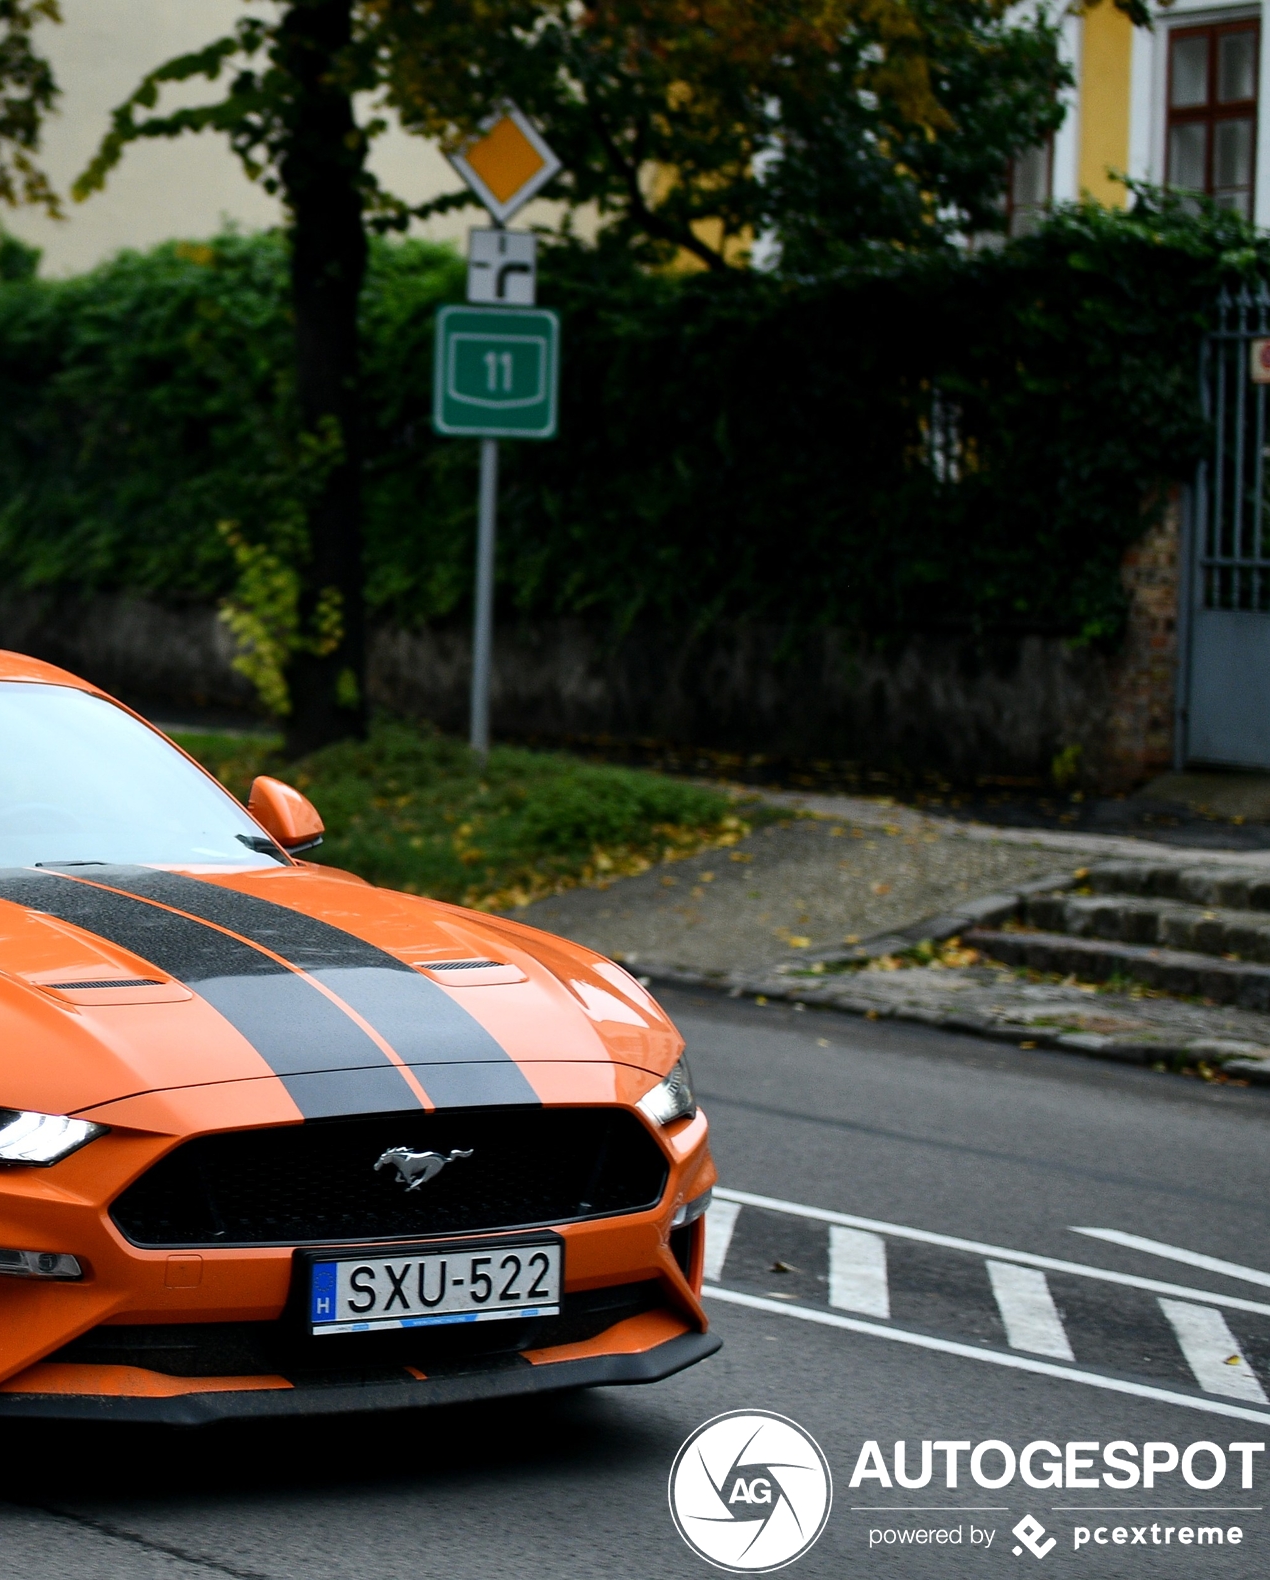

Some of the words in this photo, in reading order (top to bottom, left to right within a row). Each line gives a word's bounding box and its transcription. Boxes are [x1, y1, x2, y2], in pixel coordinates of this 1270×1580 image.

[484, 351, 513, 391] 11
[346, 1251, 550, 1313] SXU-522
[316, 1297, 330, 1314] H
